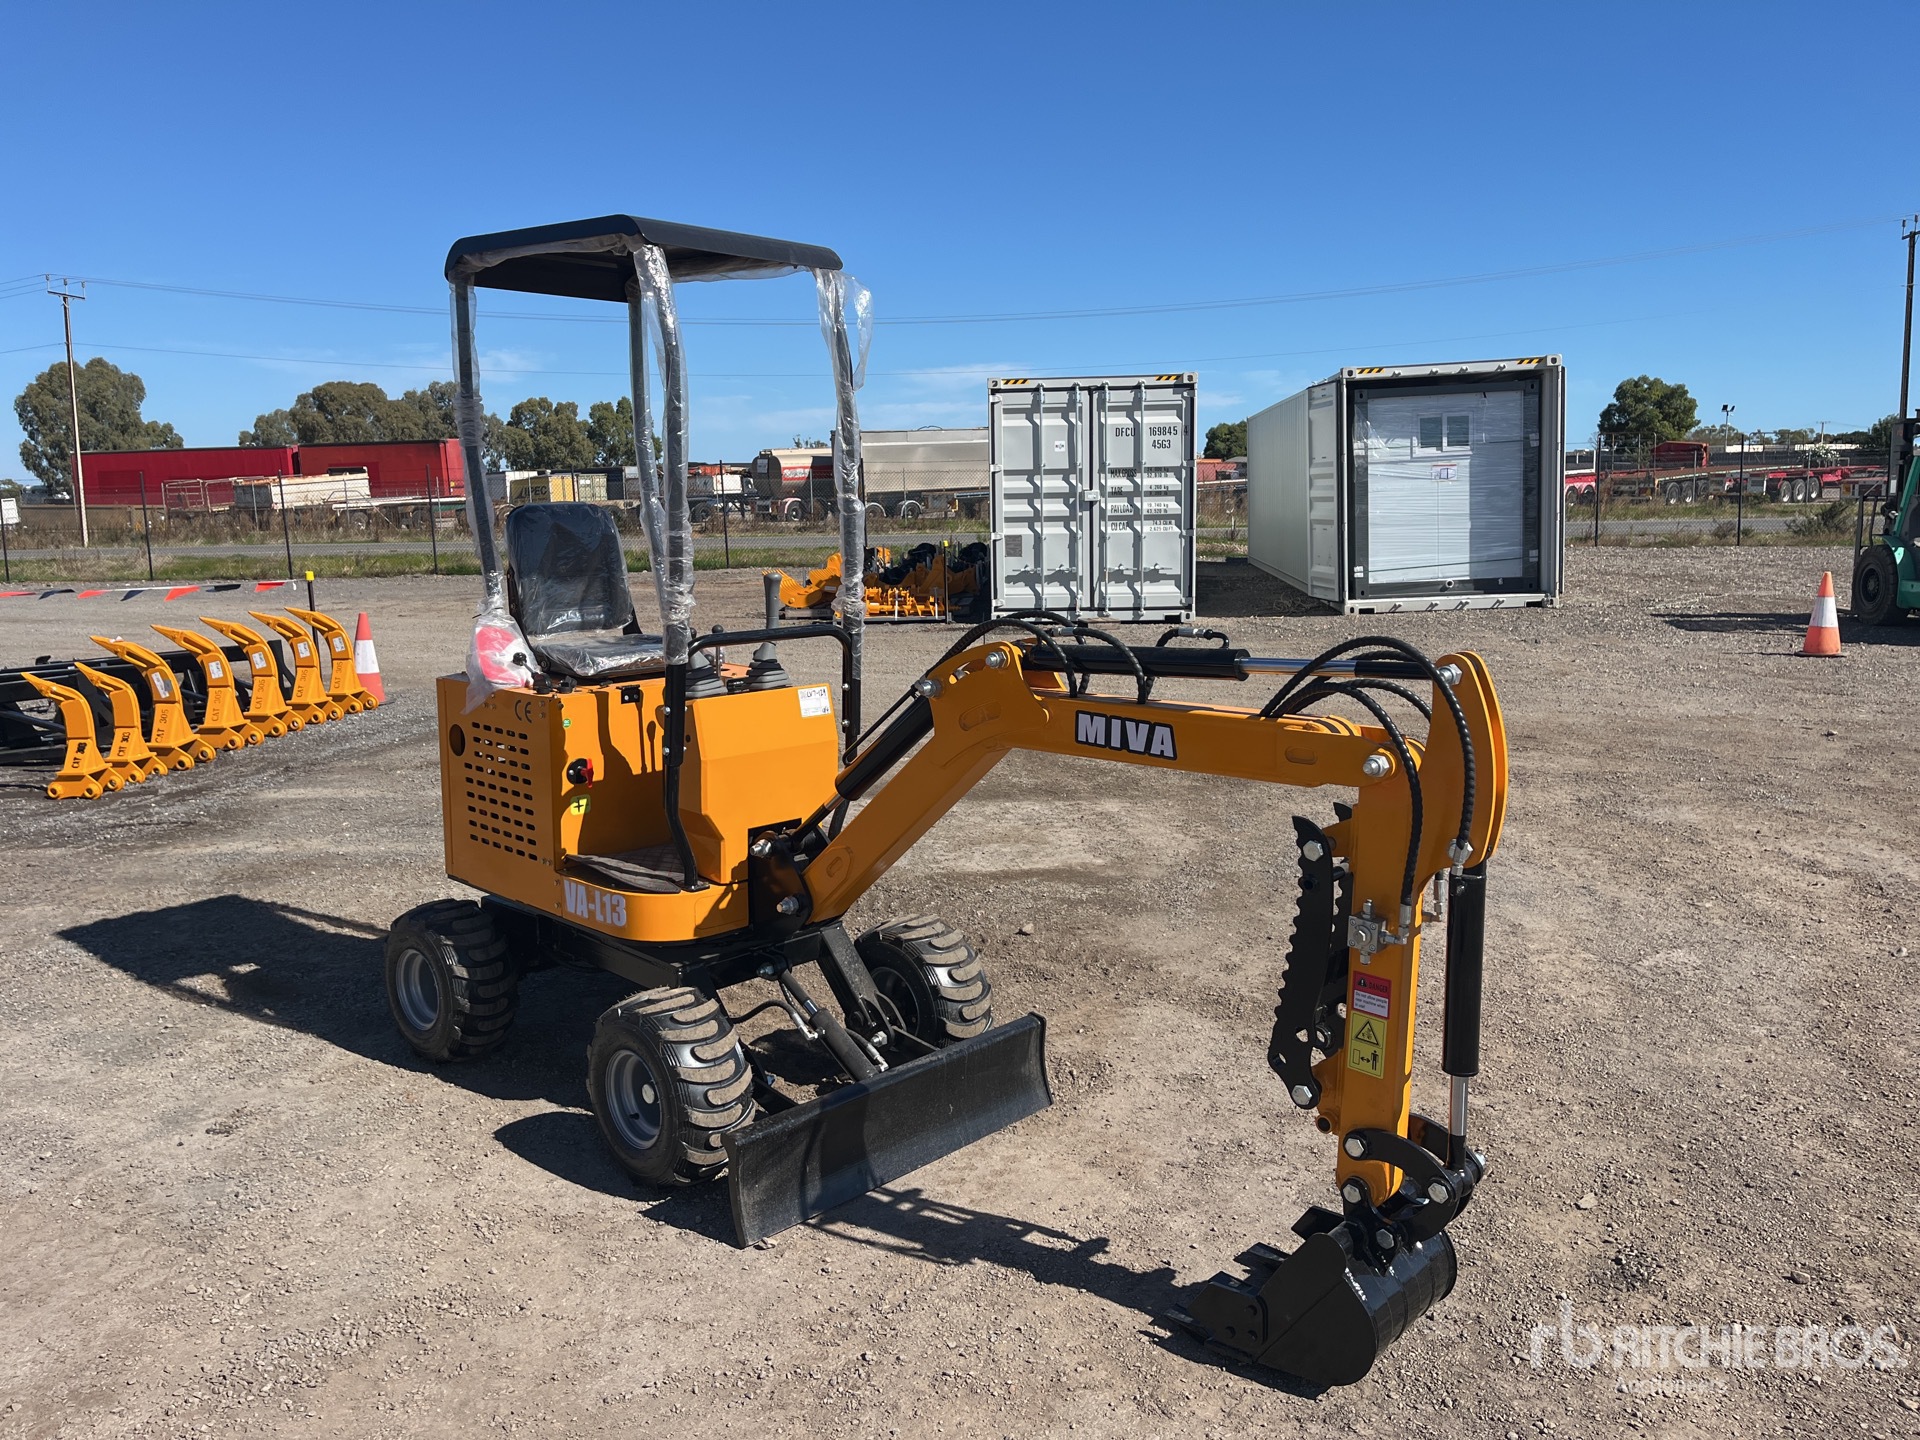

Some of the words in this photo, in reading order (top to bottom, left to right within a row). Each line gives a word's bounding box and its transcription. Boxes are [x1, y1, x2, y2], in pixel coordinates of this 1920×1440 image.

[1115, 427, 1136, 437] DFCU
[1148, 426, 1178, 437] 169845
[1152, 439, 1171, 449] 45G3
[1110, 504, 1134, 514] PAYLOAD
[333, 676, 341, 689] CAT
[296, 686, 304, 698] CAT
[254, 697, 262, 710] CAT
[212, 708, 220, 722] CAT
[155, 728, 165, 743] CAT
[160, 709, 169, 724] 305
[1076, 711, 1176, 759] MIVA
[118, 746, 127, 757] CAT
[71, 756, 81, 769] CAT
[563, 879, 627, 927] VA-L13
[1368, 982, 1388, 993] DANGER
